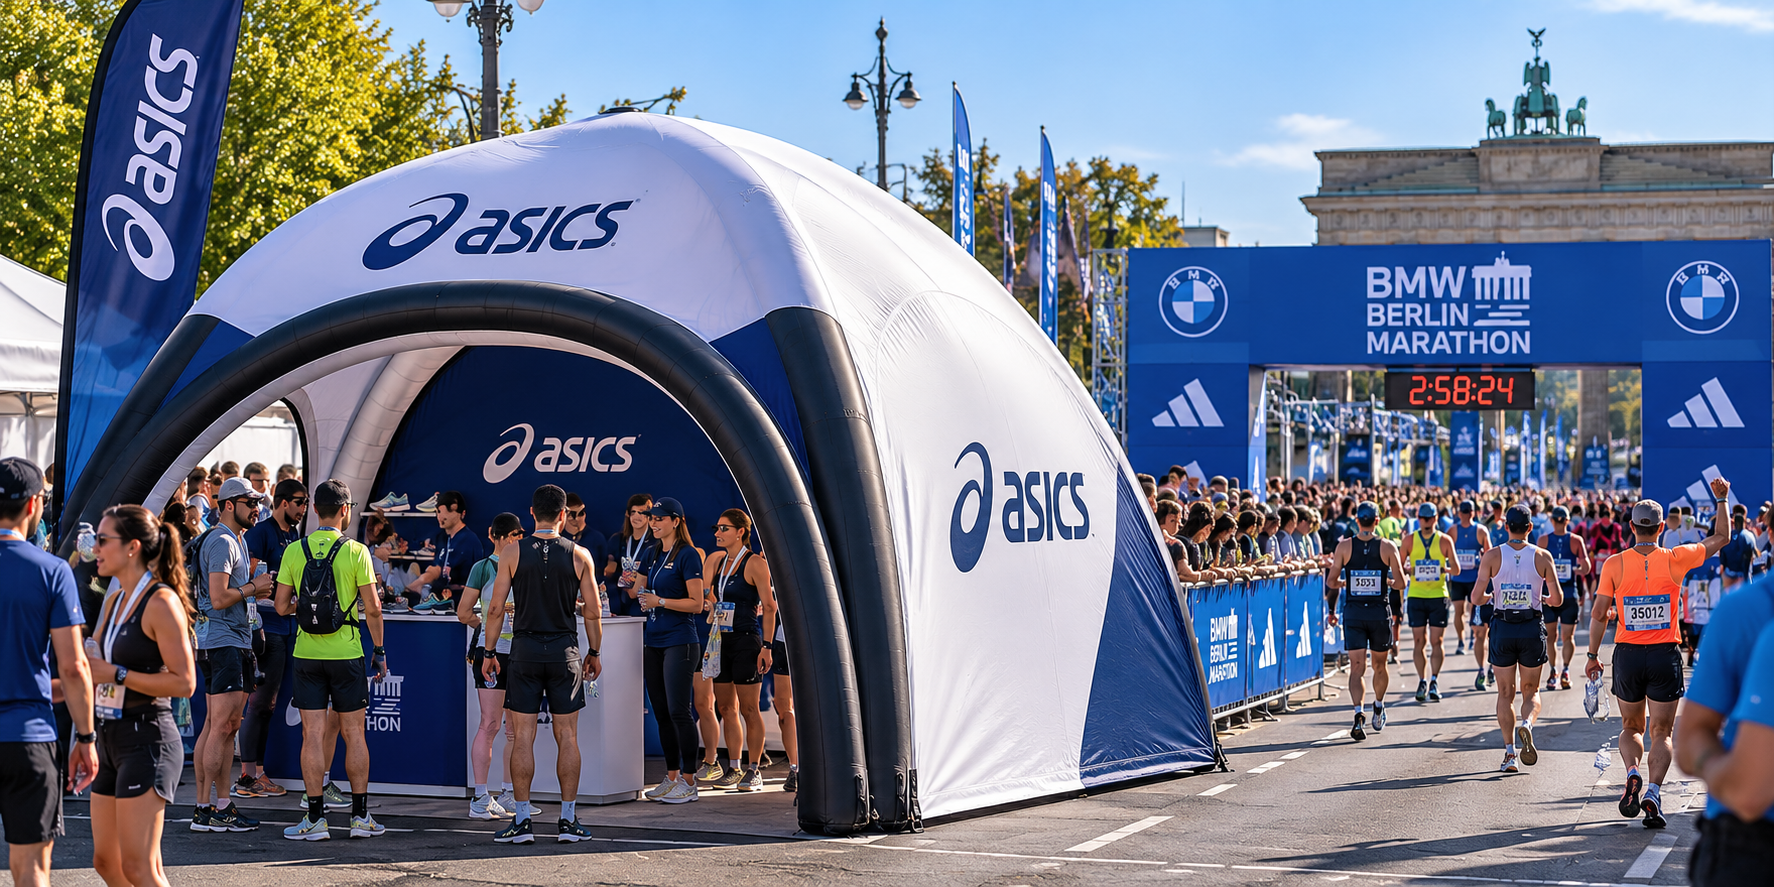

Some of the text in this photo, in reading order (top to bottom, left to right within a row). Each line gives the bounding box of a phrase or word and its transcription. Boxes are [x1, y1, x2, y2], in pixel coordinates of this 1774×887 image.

[1367, 266, 1467, 298] BMW
[1367, 303, 1468, 326] BERLIN
[1367, 331, 1530, 354] MARATHON
[1409, 375, 1514, 405] 2:58:24
[1631, 606, 1664, 619] 35012
